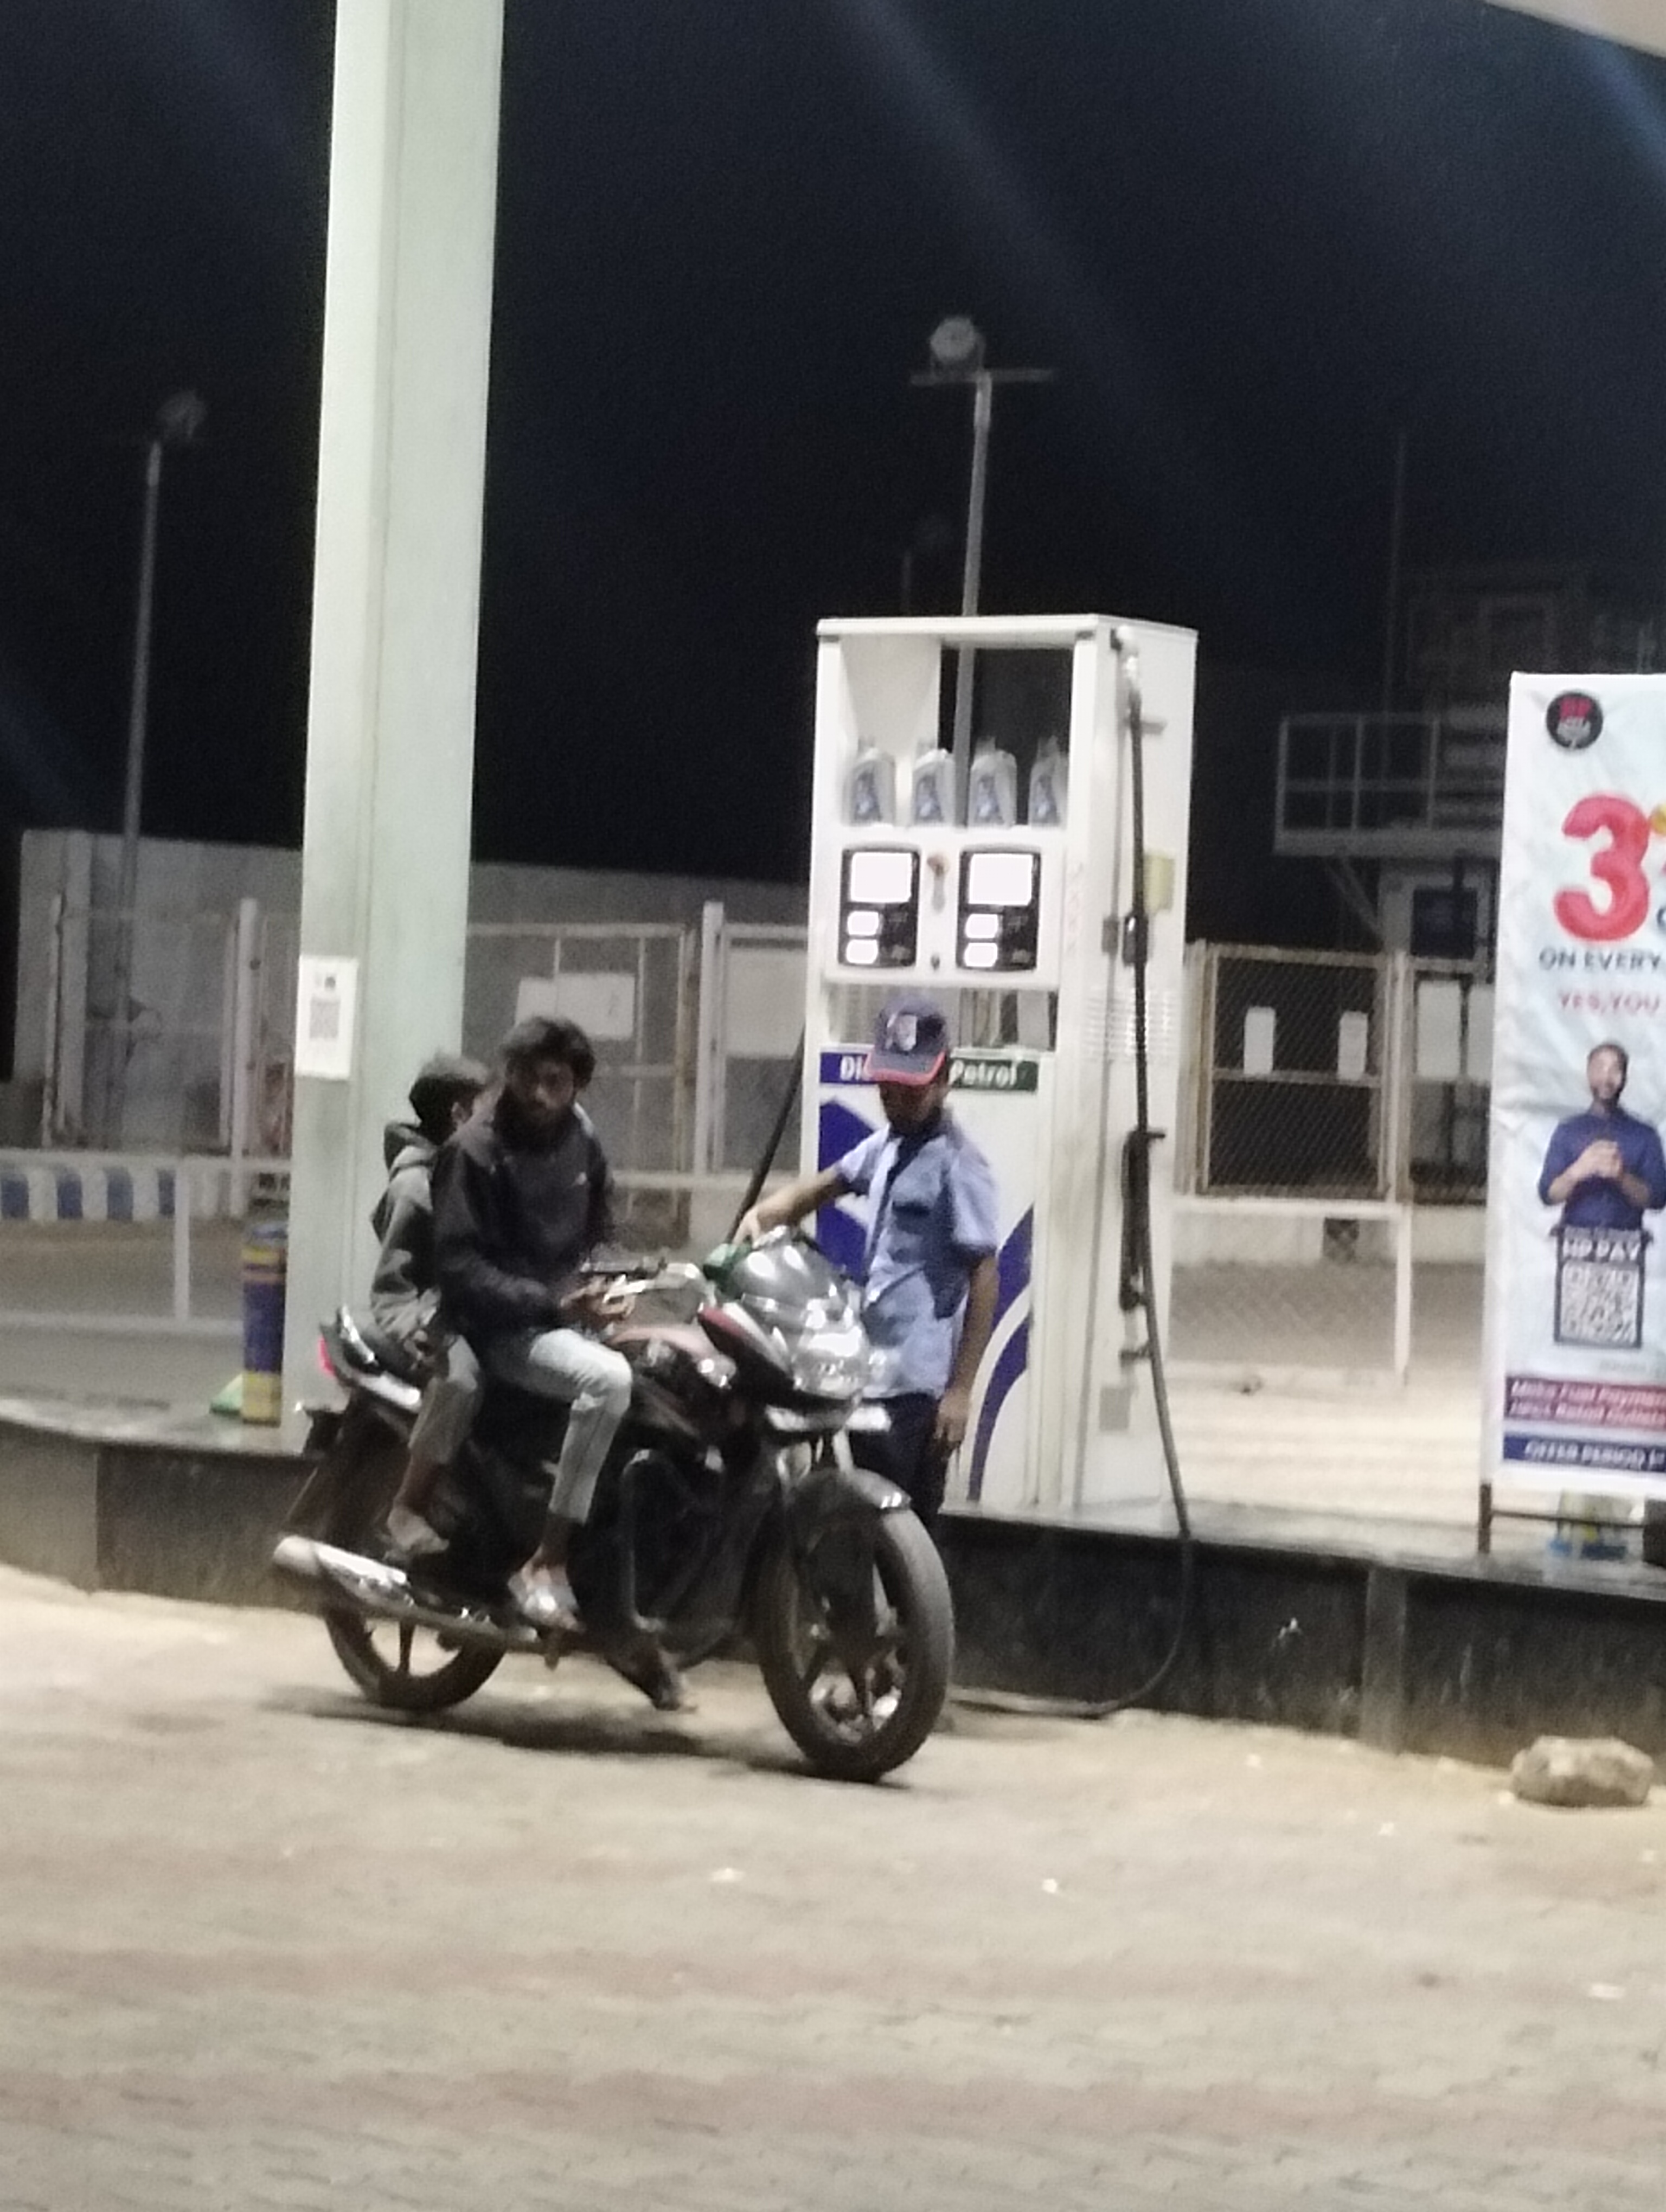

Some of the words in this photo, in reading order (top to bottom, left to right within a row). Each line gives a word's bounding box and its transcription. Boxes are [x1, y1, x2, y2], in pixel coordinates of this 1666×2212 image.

[1553, 793, 1650, 941] 3
[1539, 948, 1576, 970] ON
[1584, 950, 1661, 972] EVERY
[950, 1059, 1018, 1085] Petrol
